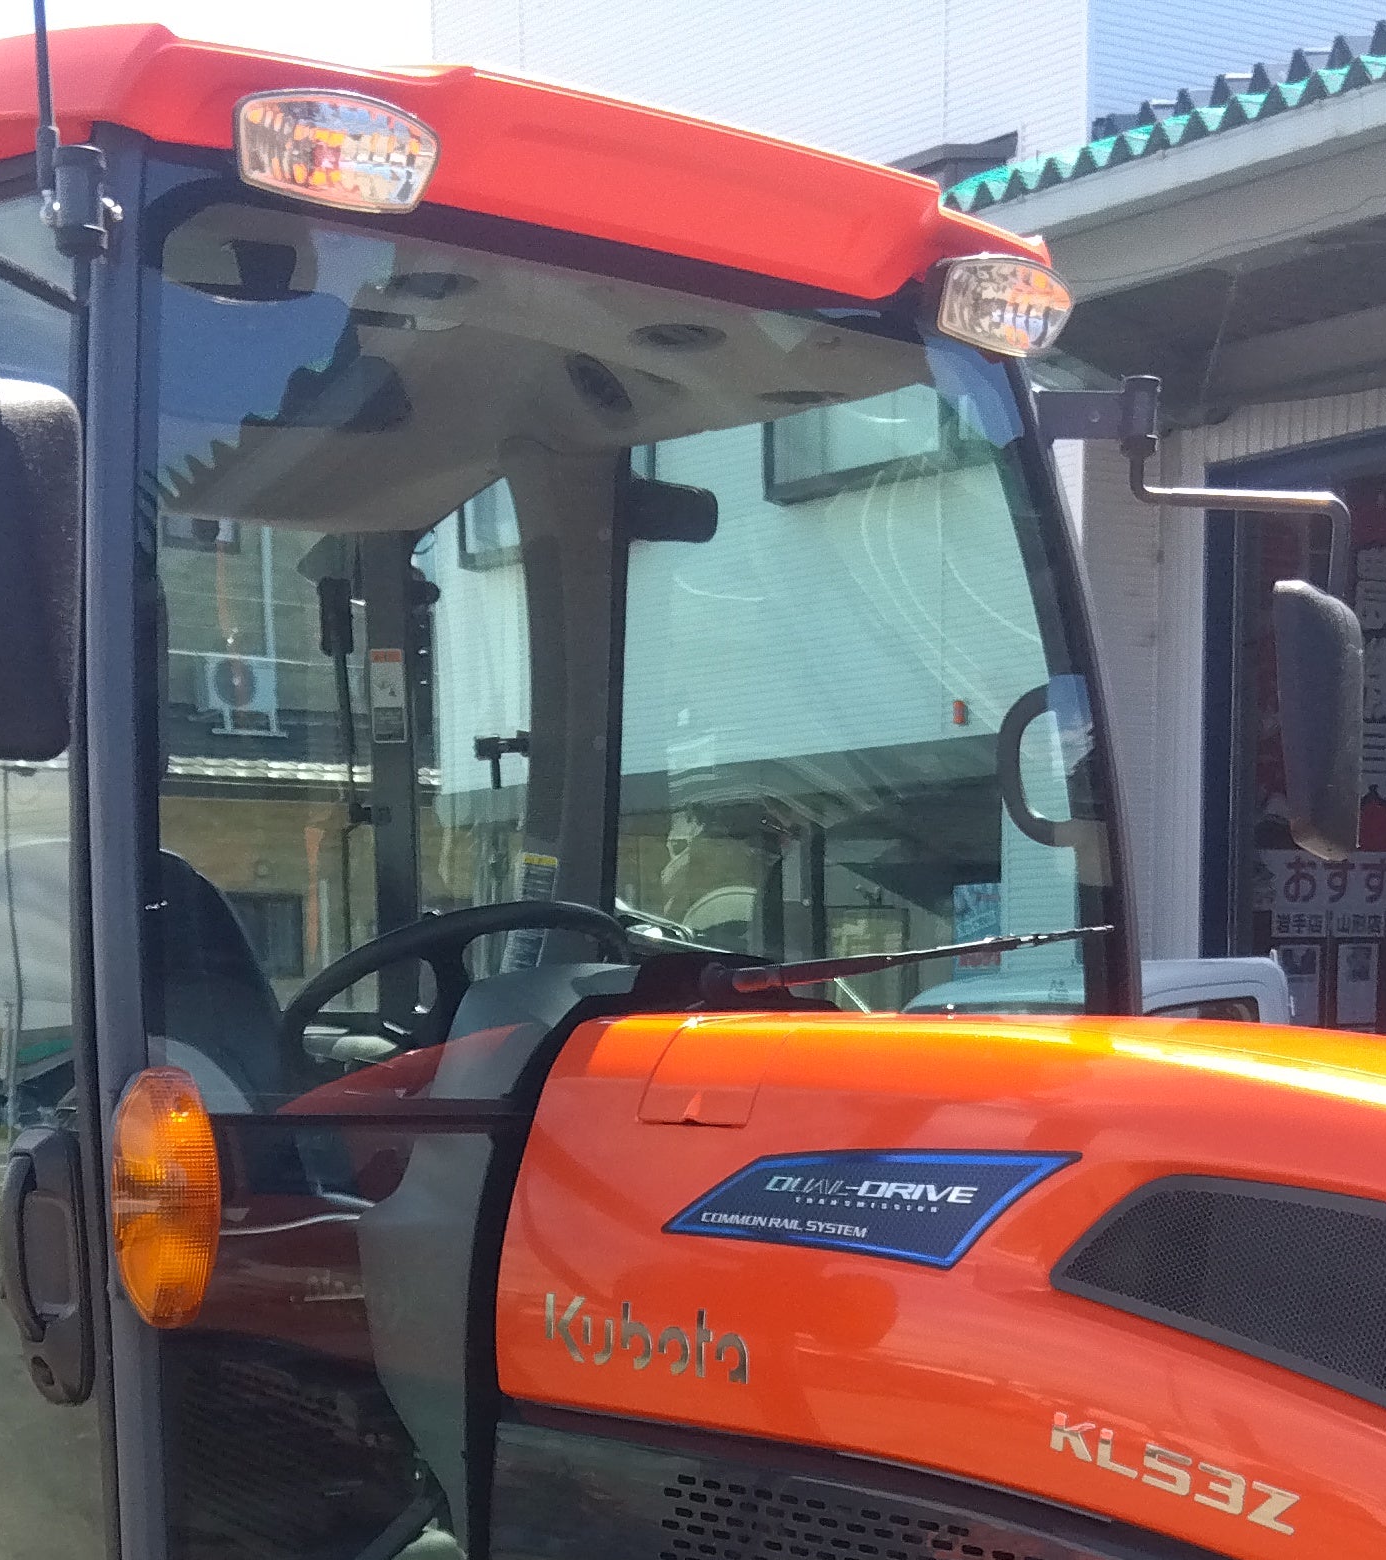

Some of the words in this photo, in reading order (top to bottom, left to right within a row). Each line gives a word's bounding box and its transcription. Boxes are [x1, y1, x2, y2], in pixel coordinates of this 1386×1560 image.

[1336, 914, 1382, 933] 山形店
[764, 1175, 979, 1205] DUAL-DRIVE
[700, 1211, 767, 1228] COMMON
[768, 1216, 803, 1232] RAIL
[806, 1220, 868, 1239] SYSTEM
[543, 1291, 750, 1385] Kubota
[1049, 1411, 1303, 1537] KL53Z
